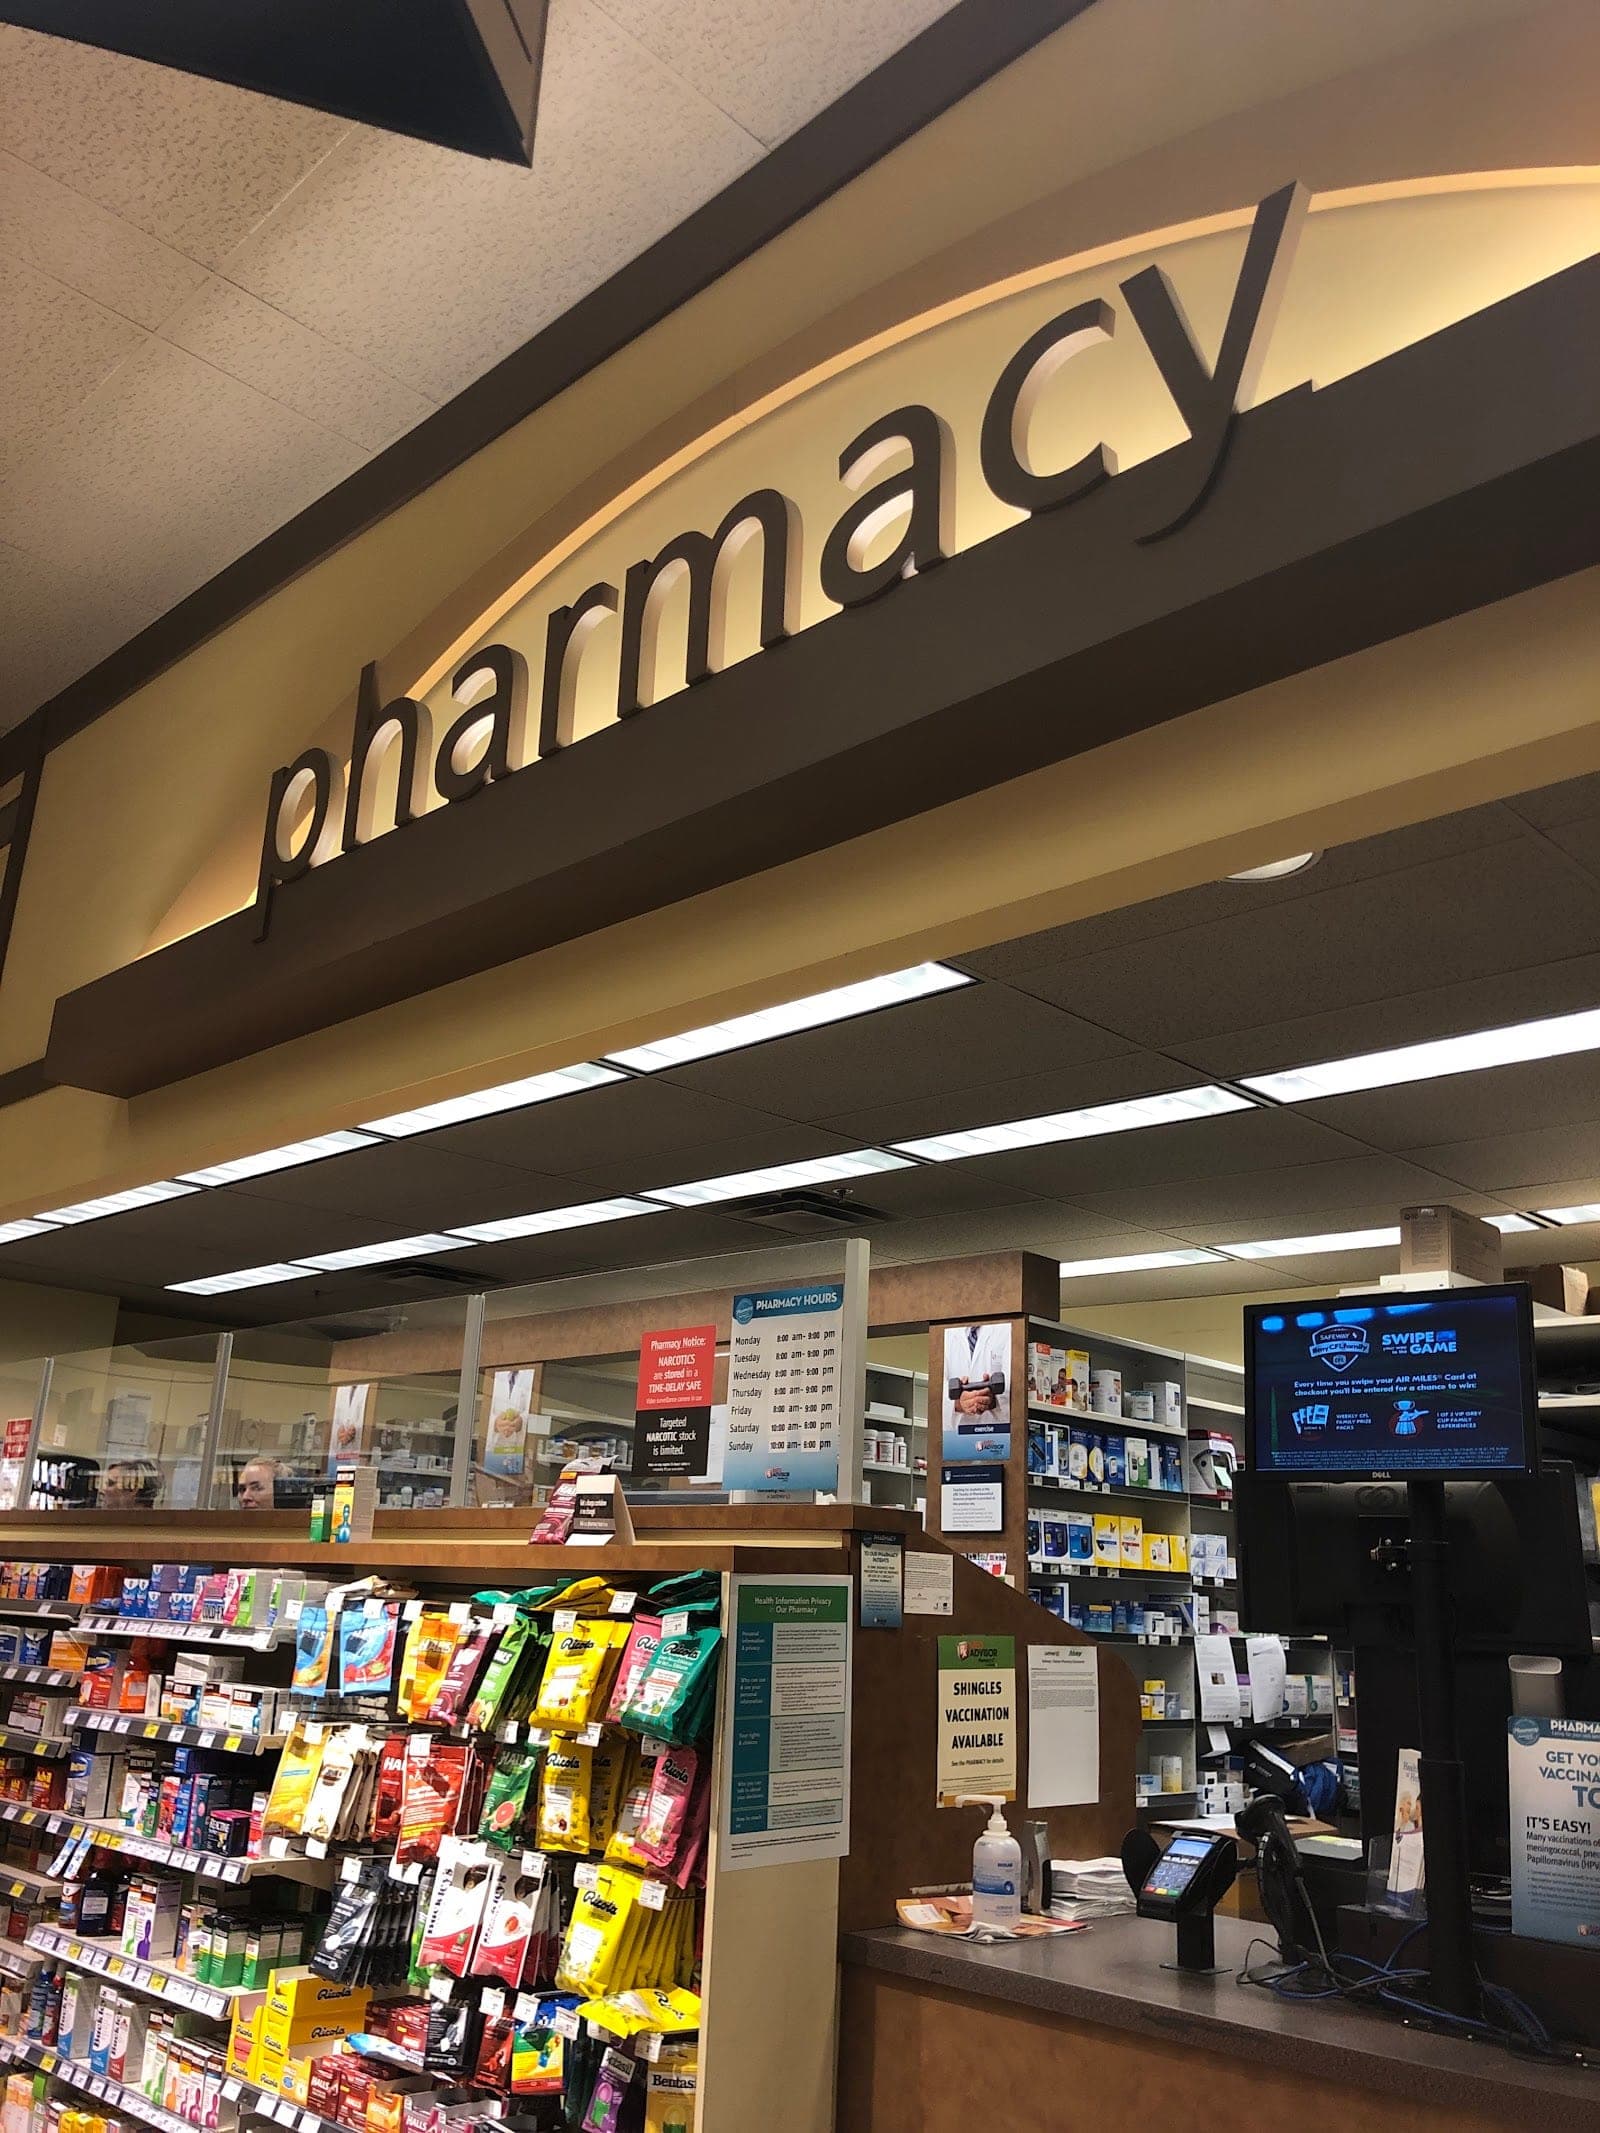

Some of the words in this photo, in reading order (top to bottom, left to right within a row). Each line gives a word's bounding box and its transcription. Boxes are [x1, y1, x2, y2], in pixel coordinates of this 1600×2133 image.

[253, 180, 1312, 941] pharmacy
[756, 1298, 802, 1310] PHARMACY
[804, 1292, 837, 1306] HOURS
[651, 1339, 680, 1351] Pharmacy
[682, 1335, 706, 1348] Notice:
[736, 1336, 760, 1346] Monday
[824, 1330, 835, 1340] pm
[1320, 1333, 1349, 1341] SAFEWAY
[1382, 1332, 1434, 1346] SWIPE
[1410, 1342, 1457, 1354] GAME
[658, 1354, 695, 1367] NARCOTICS
[734, 1353, 760, 1363] Tuesday
[823, 1348, 834, 1358] pm
[664, 1369, 684, 1379] stored
[734, 1370, 770, 1380] Wednesday
[822, 1366, 834, 1376] pm
[649, 1382, 684, 1393] TIME-DELAY
[686, 1380, 702, 1391] SAFE
[1294, 1380, 1314, 1389] Every
[1316, 1379, 1333, 1387] time
[1336, 1379, 1349, 1388] you
[1351, 1377, 1374, 1386] swipe
[1376, 1377, 1393, 1386] your
[1396, 1375, 1410, 1383] AIR
[1444, 1373, 1465, 1381] Card
[732, 1388, 762, 1398] Thursday
[822, 1384, 833, 1394] pm
[1294, 1388, 1327, 1396] checkout
[1331, 1387, 1350, 1396] you'll
[1364, 1385, 1393, 1393] entered
[1396, 1384, 1407, 1392] for
[1417, 1383, 1446, 1391] chance
[731, 1406, 752, 1416] Friday
[821, 1403, 832, 1412] pm
[660, 1417, 687, 1430] Targeted
[730, 1424, 759, 1434] Saturday
[821, 1421, 831, 1431] pm
[646, 1432, 677, 1442] NARCOTIC
[678, 1430, 696, 1441] stock
[653, 1445, 659, 1455] is
[729, 1441, 753, 1452] Sunday
[820, 1440, 831, 1450] pm
[755, 1597, 773, 1605] Health
[775, 1597, 808, 1605] Information
[810, 1597, 831, 1607] Privacy
[776, 1605, 788, 1613] Our
[789, 1606, 817, 1616] Pharmacy
[561, 1638, 594, 1650] Ricola
[637, 1637, 658, 1651] Ric
[664, 1642, 699, 1659] Ricola
[970, 1648, 998, 1657] ADVISOR
[953, 1681, 1002, 1696] SHINGLES
[946, 1707, 1009, 1722] VACCINATION
[952, 1733, 1004, 1749] AVAILABLE
[545, 1753, 580, 1768] Ricola
[1546, 1750, 1574, 1765] GET
[1577, 1752, 1600, 1767] YO
[661, 1759, 689, 1783] Ricola
[1527, 1816, 1550, 1830] IT'S
[1553, 1819, 1591, 1834] EASY!
[1527, 1832, 1546, 1844] Many
[1548, 1835, 1592, 1846] vaccinations
[1527, 1854, 1580, 1868] Papillomavirus
[583, 1890, 618, 1915] Ricola
[317, 1985, 353, 2000] Ricola
[270, 1998, 289, 2012] Ricola
[236, 2024, 253, 2039] Ricola
[311, 2025, 345, 2039] Ricola
[264, 2035, 282, 2050] Ricola
[230, 2062, 248, 2077] Ricola
[260, 2073, 279, 2089] Ricola
[311, 2079, 331, 2093] HALLS
[653, 2074, 697, 2089] Bentas
[405, 2112, 434, 2131] HALLS
